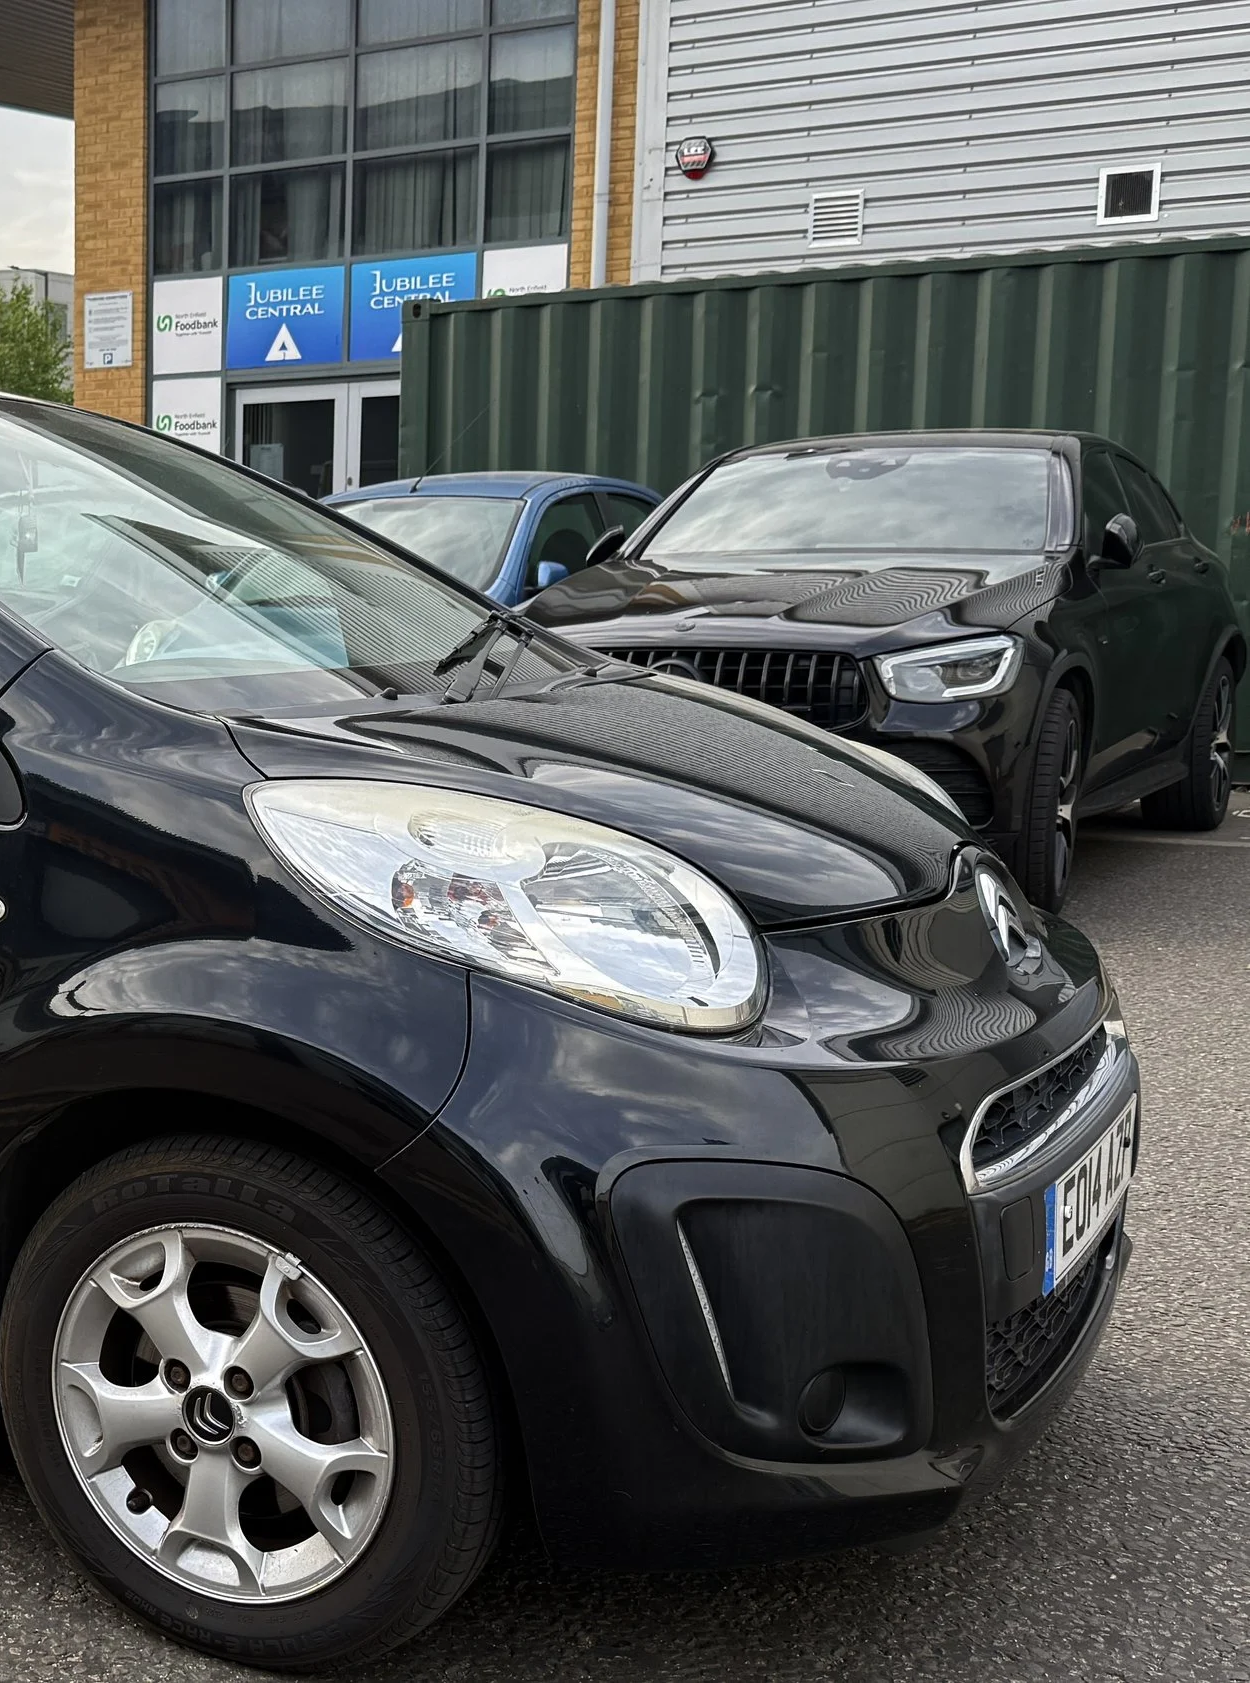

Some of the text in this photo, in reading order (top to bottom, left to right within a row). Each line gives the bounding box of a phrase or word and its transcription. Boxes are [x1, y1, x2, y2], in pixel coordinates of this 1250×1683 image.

[370, 270, 456, 296] JUBILEE
[246, 282, 325, 307] JUBILEE
[245, 303, 325, 321] CENTRAL
[175, 318, 219, 331] Foodbank
[174, 419, 218, 431] Foodbank
[1062, 1145, 1103, 1258] EO14
